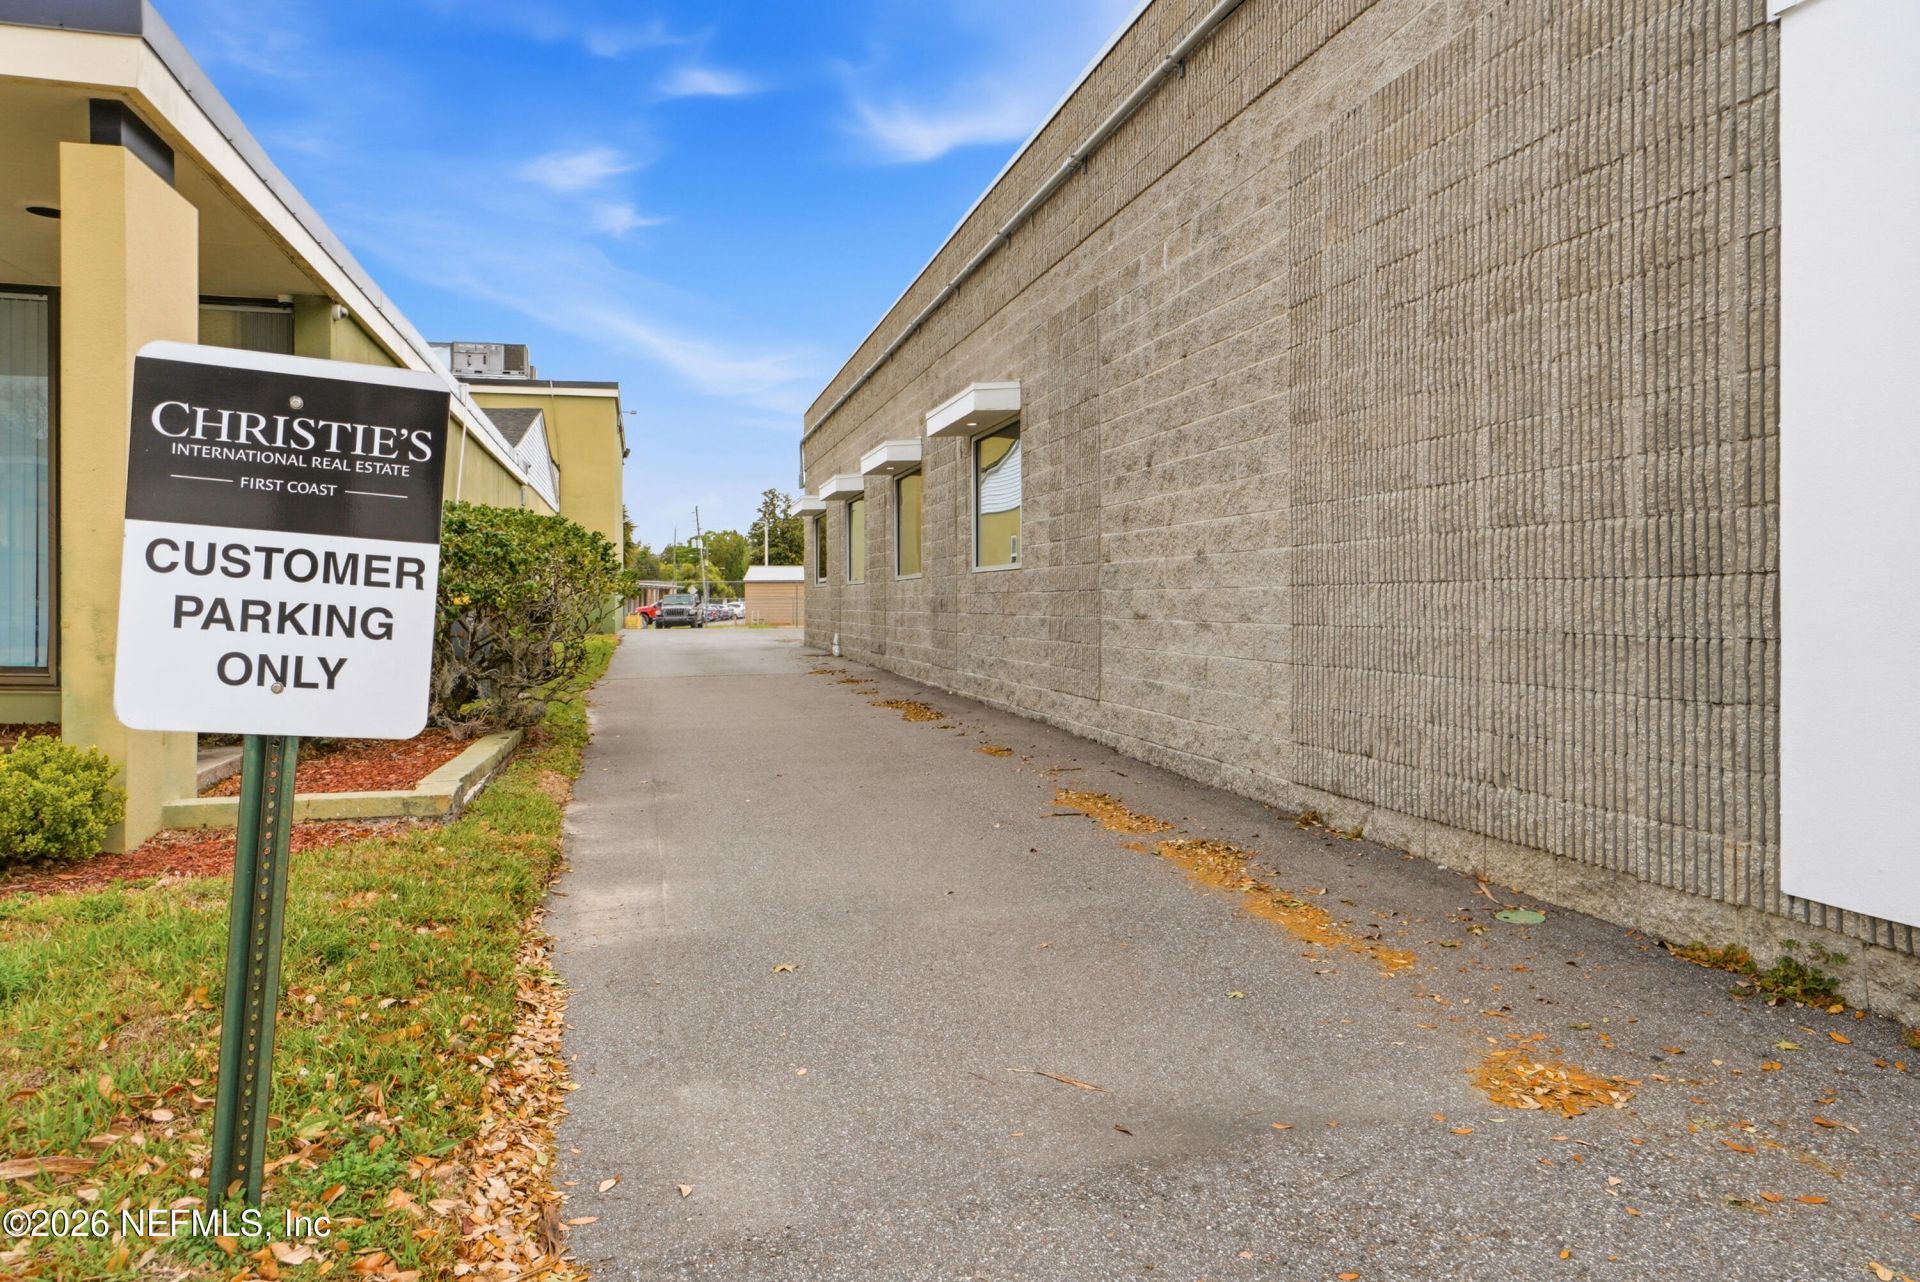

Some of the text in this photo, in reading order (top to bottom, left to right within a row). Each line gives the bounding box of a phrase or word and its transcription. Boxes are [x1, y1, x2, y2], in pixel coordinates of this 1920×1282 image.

[151, 401, 433, 462] CHRISTIE'S
[171, 443, 410, 477] INTERNATIONAL REAL ESTATE
[240, 477, 338, 496] FIRST COAST
[145, 537, 426, 591] CUSTOMER
[173, 594, 394, 641] PARKING
[217, 651, 348, 690] ONLY
